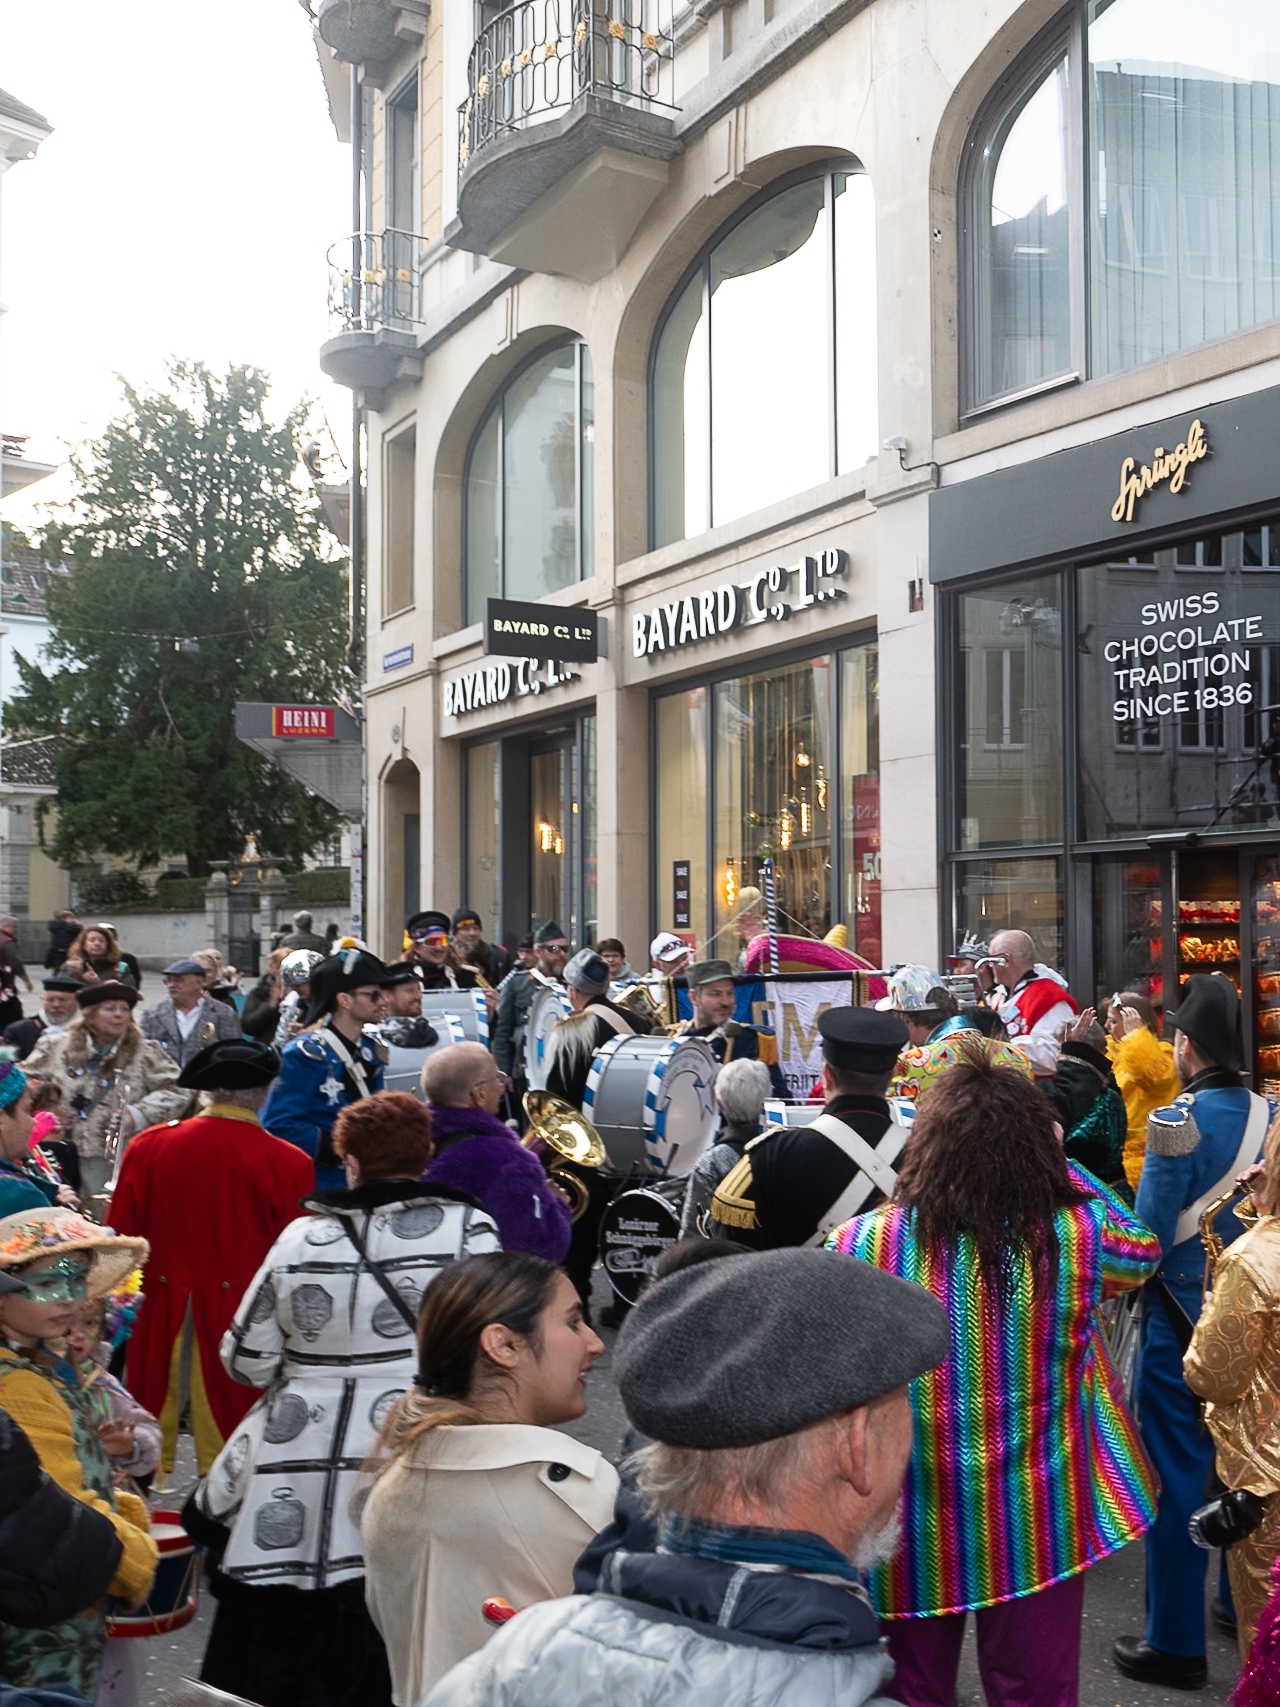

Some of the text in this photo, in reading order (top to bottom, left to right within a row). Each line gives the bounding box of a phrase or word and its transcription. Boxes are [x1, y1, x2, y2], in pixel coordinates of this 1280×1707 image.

[1111, 418, 1207, 522] Sprüngli
[493, 619, 549, 637] BAYARD
[633, 583, 737, 658] BAYARD
[1141, 591, 1220, 626] SWISS
[1104, 615, 1263, 662] CHOCOLATE
[443, 662, 511, 717] BAYARD
[1113, 650, 1250, 691] TRADITION
[282, 710, 327, 728] HEINI
[1113, 683, 1253, 721] SINCE 1836
[282, 727, 327, 735] LUZERN
